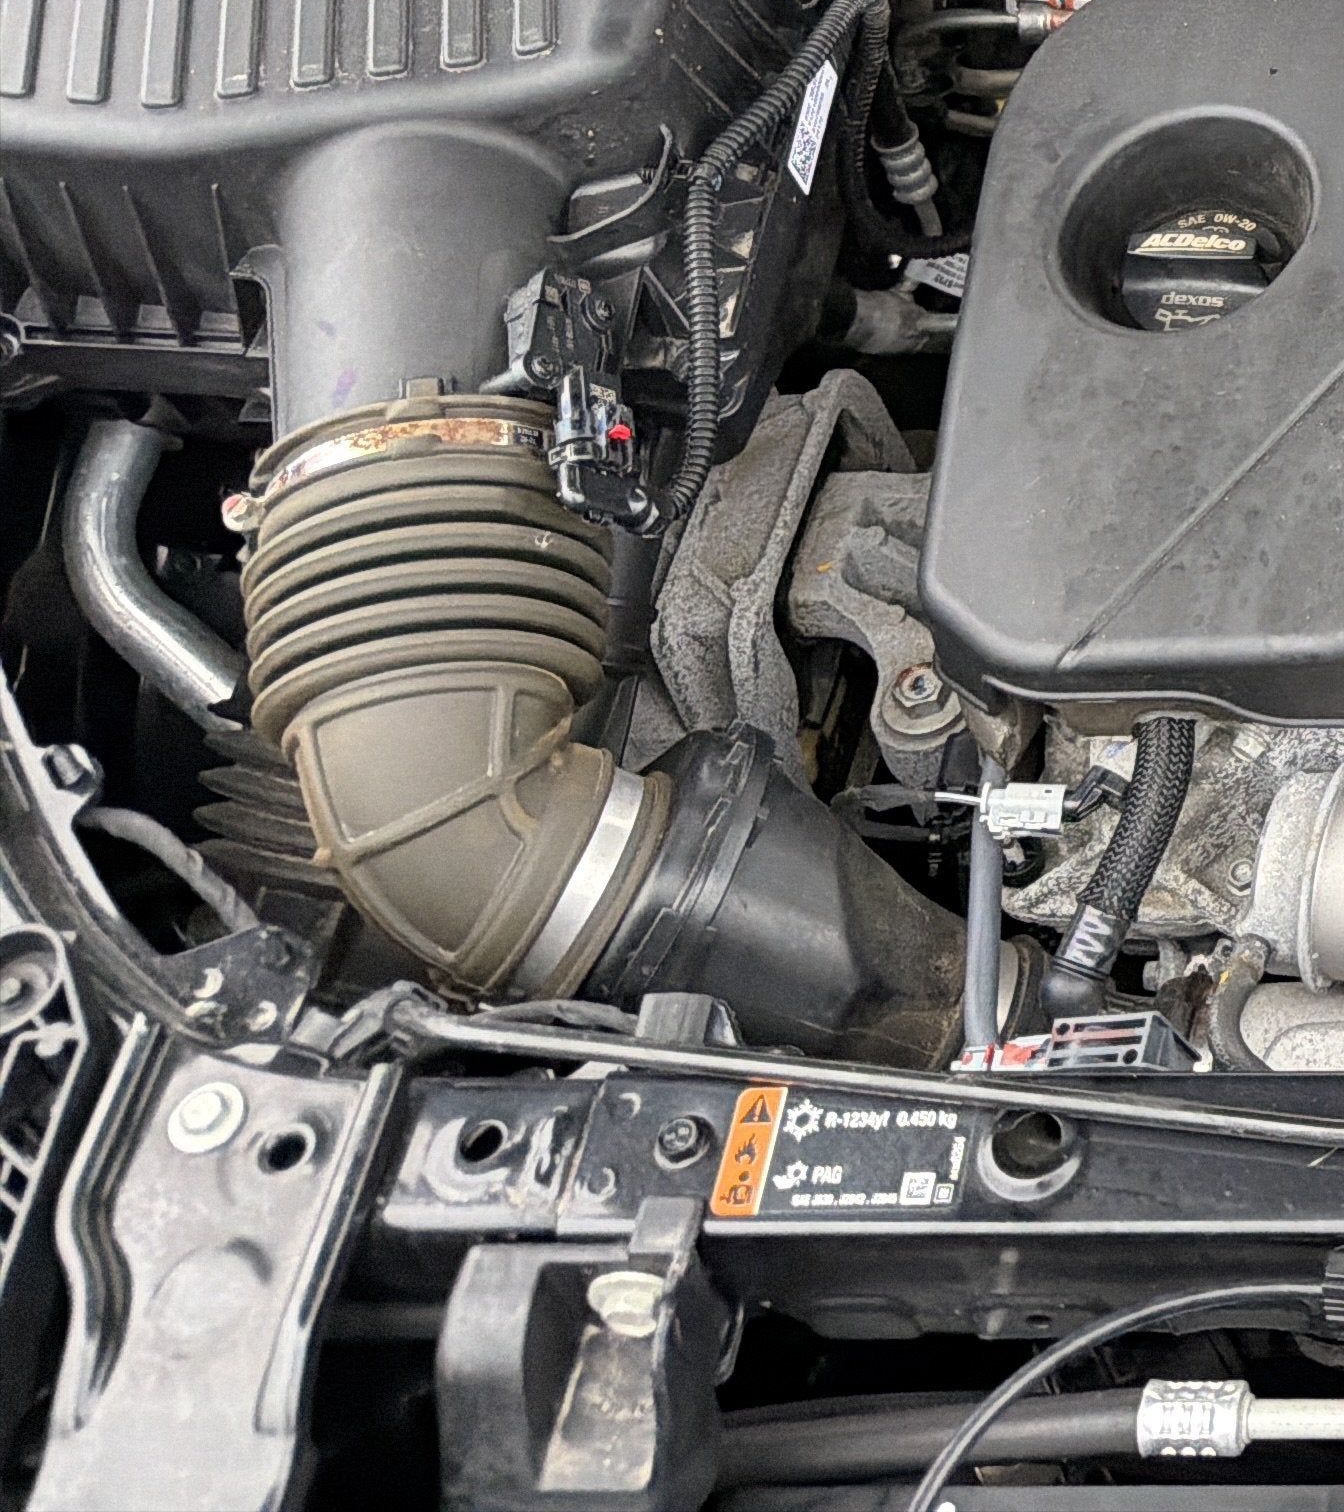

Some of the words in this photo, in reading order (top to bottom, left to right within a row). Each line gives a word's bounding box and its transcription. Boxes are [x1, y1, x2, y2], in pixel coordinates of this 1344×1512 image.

[1177, 214, 1207, 229] SAE
[1213, 213, 1257, 232] 0W-20
[1140, 233, 1247, 251] ACDelco
[1160, 292, 1226, 308] dexos
[895, 1110, 938, 1129] 0.450
[938, 1110, 958, 1130] kg
[811, 1165, 844, 1186] PAG
